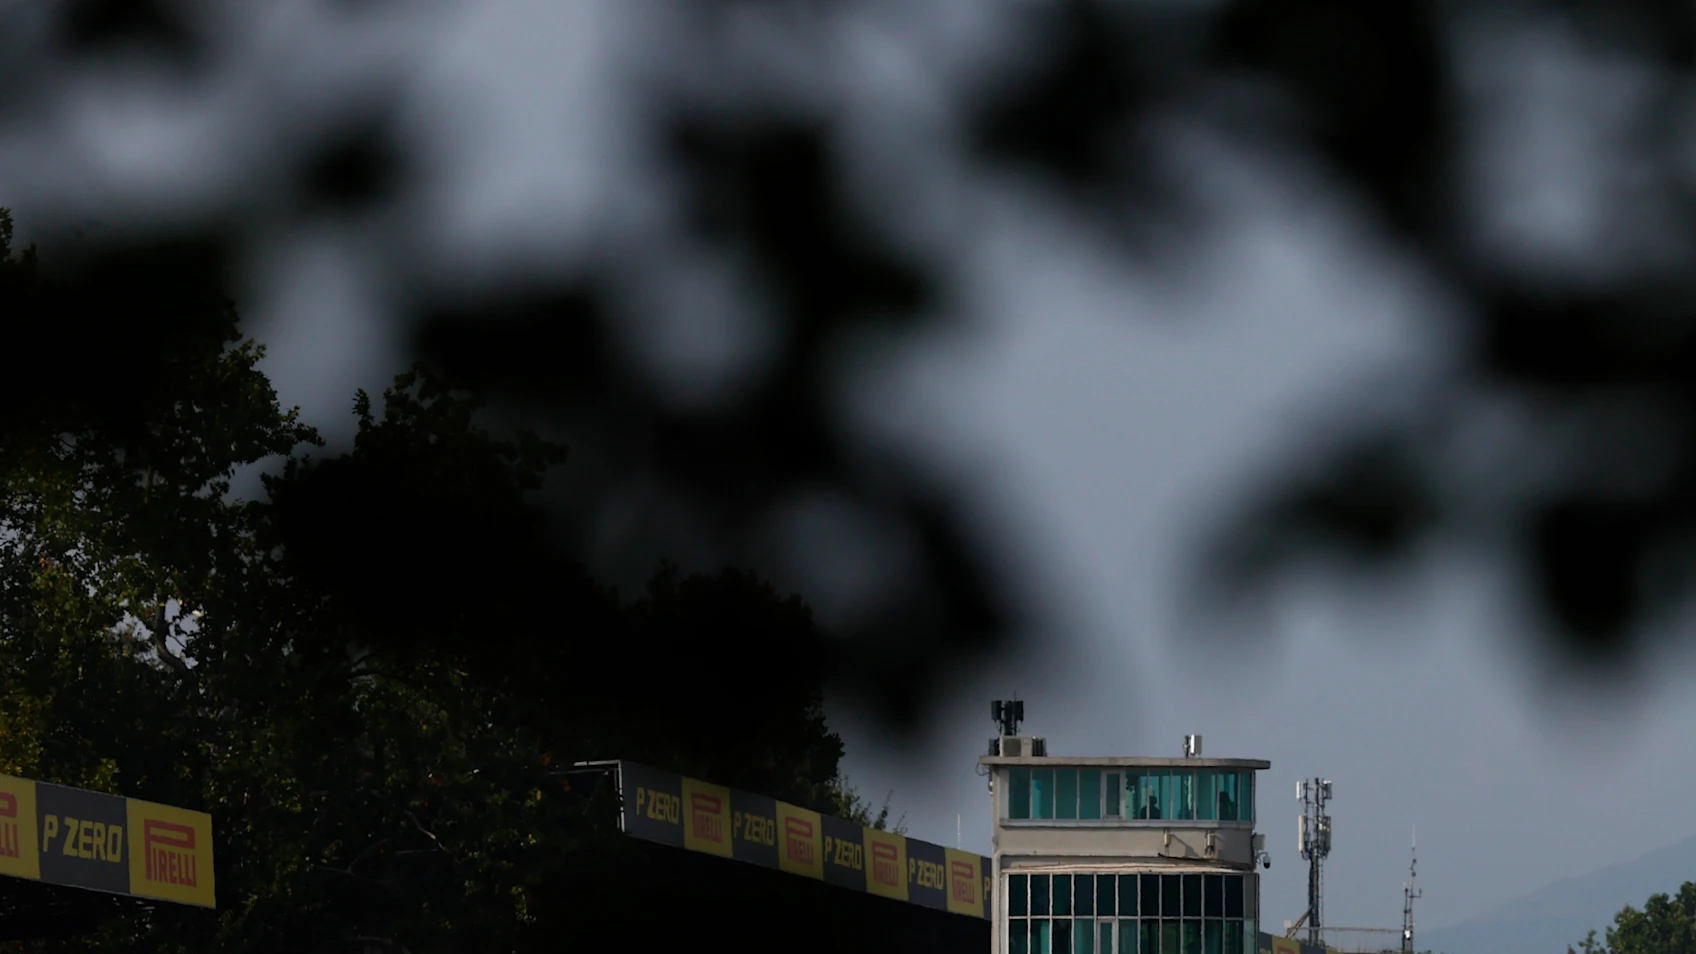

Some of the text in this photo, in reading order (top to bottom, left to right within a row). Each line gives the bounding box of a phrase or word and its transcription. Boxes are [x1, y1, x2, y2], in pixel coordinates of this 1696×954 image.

[636, 787, 680, 825] P ZERO
[691, 792, 722, 843] PIRELLI
[43, 814, 58, 852] P
[63, 817, 123, 863] ZERO
[733, 811, 775, 846] P ZERO
[144, 818, 197, 887] PIRELLI
[824, 836, 862, 870] P ZERO
[909, 858, 944, 891] P ZERO
